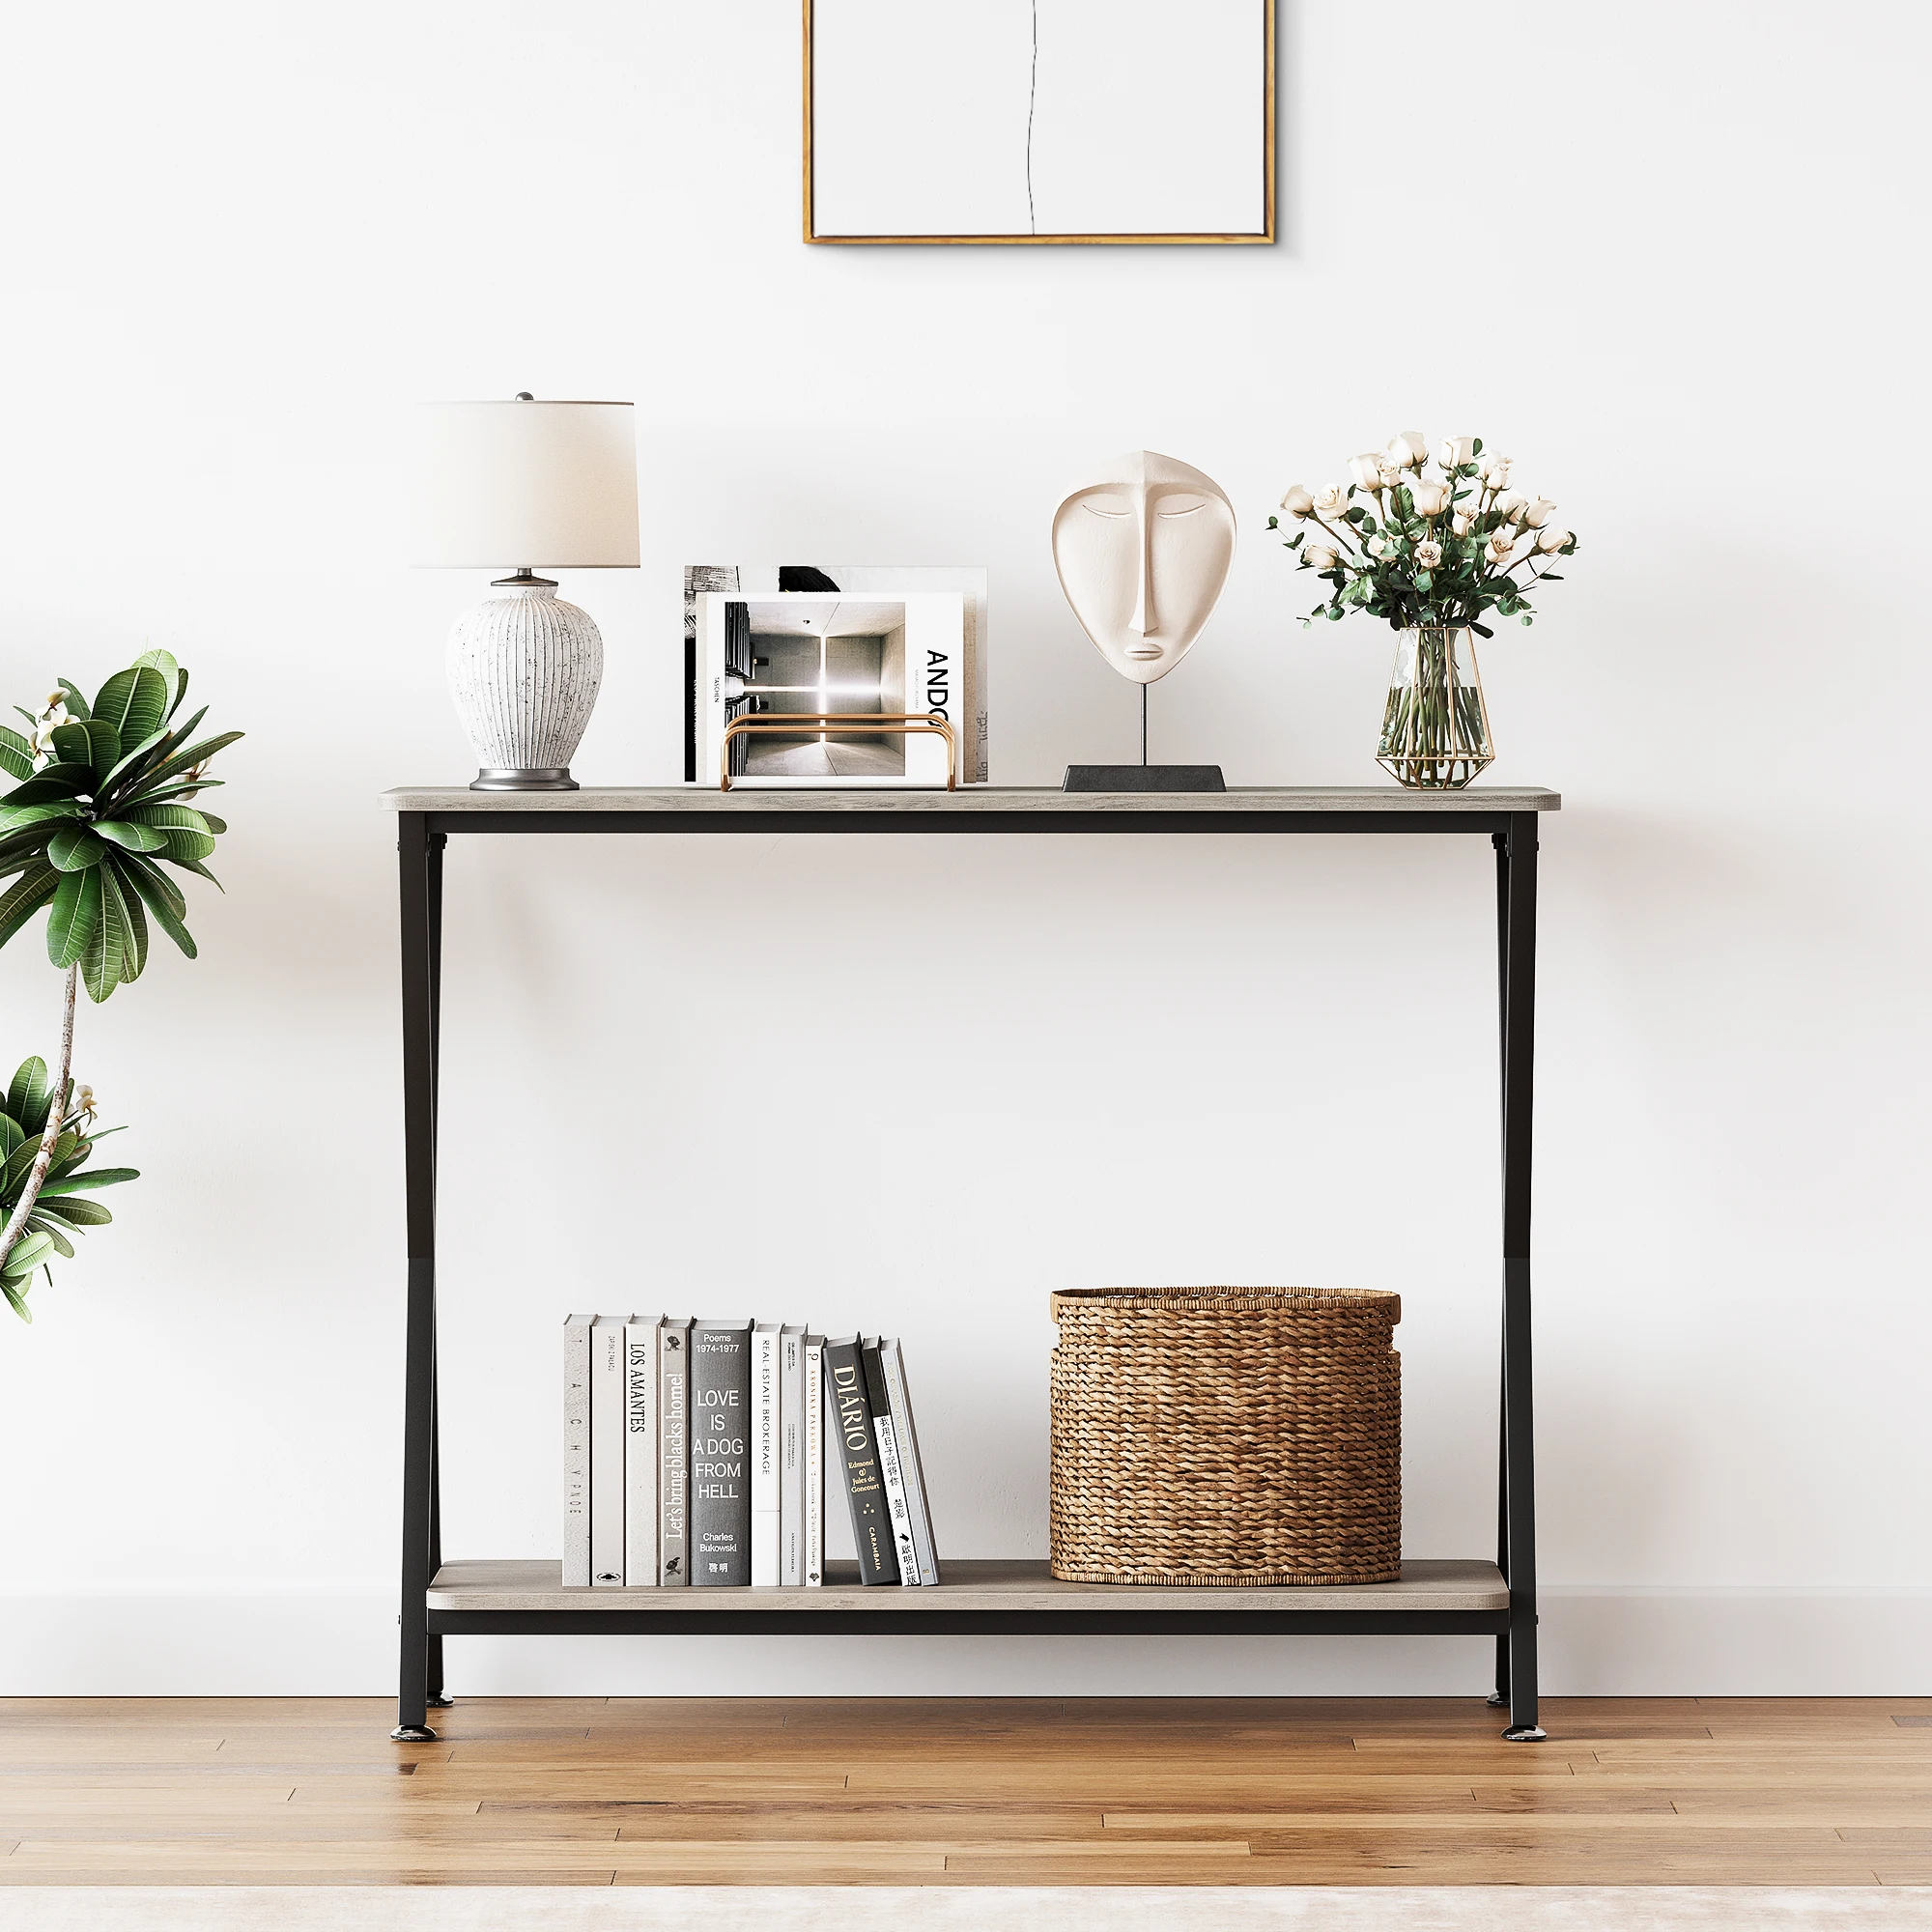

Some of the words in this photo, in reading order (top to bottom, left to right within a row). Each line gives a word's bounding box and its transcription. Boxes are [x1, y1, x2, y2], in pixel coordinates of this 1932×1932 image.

[630, 1344, 645, 1366] LOS
[696, 1344, 739, 1352] 1974-1977
[630, 1370, 645, 1433] AMANTES
[666, 1373, 683, 1420] home!
[696, 1389, 739, 1406] LOVE
[833, 1364, 867, 1451] DIÁRIO
[710, 1413, 725, 1431] IS
[666, 1422, 683, 1468] blacks
[693, 1438, 704, 1455] A
[707, 1437, 744, 1455] DOG
[695, 1463, 741, 1478] FROM
[848, 1459, 874, 1469] Edmond
[666, 1469, 687, 1505] bring
[851, 1483, 880, 1493] Goncourt
[852, 1477, 867, 1486] Jules
[698, 1484, 739, 1498] HELL
[666, 1507, 683, 1539] Let's
[702, 1532, 733, 1542] Charles
[699, 1544, 737, 1552] Bukowski
[868, 1526, 881, 1571] CARAMBAIA
